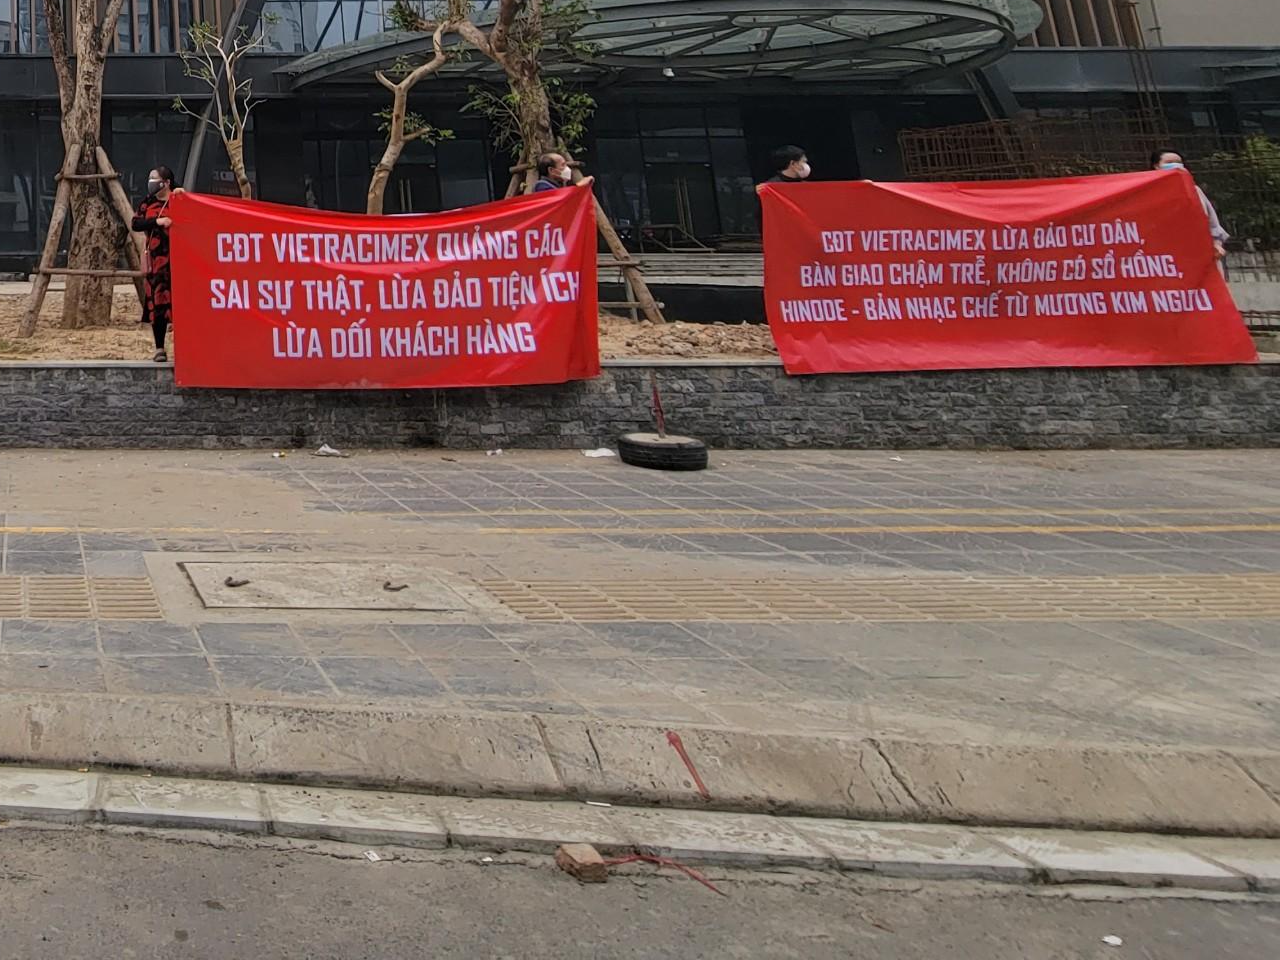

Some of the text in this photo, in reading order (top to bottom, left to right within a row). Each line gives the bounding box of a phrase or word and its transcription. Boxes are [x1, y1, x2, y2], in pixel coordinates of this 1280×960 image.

[217, 223, 566, 264] CĐT VIETRACIMEX QUẢNG CÁO
[821, 218, 1145, 253] CĐT VIETRACIMEX LỪA ĐẢO CƯ DÂN,
[800, 249, 1183, 288] BÀN GIAO CHẬM TRỄ, KHÔNG CÓ SỔ HỒNG,
[210, 279, 249, 309] SAI
[257, 280, 294, 315] SỰ
[301, 275, 371, 316] THẬT,
[379, 273, 426, 310] LỪA
[433, 271, 482, 308] ĐẢO
[488, 271, 537, 310] TIỆN
[780, 299, 847, 322] HINODE
[863, 295, 902, 320] BẢN
[906, 296, 957, 323] NHẠC
[961, 289, 1002, 318] CHẾ
[1005, 291, 1029, 316] TỪ
[1035, 292, 1107, 316] MƯƠNG
[1112, 291, 1148, 313] KIM
[1151, 288, 1213, 312] NGƯU
[273, 318, 536, 358] LỪA DỐI KHÁCH HÀNG
